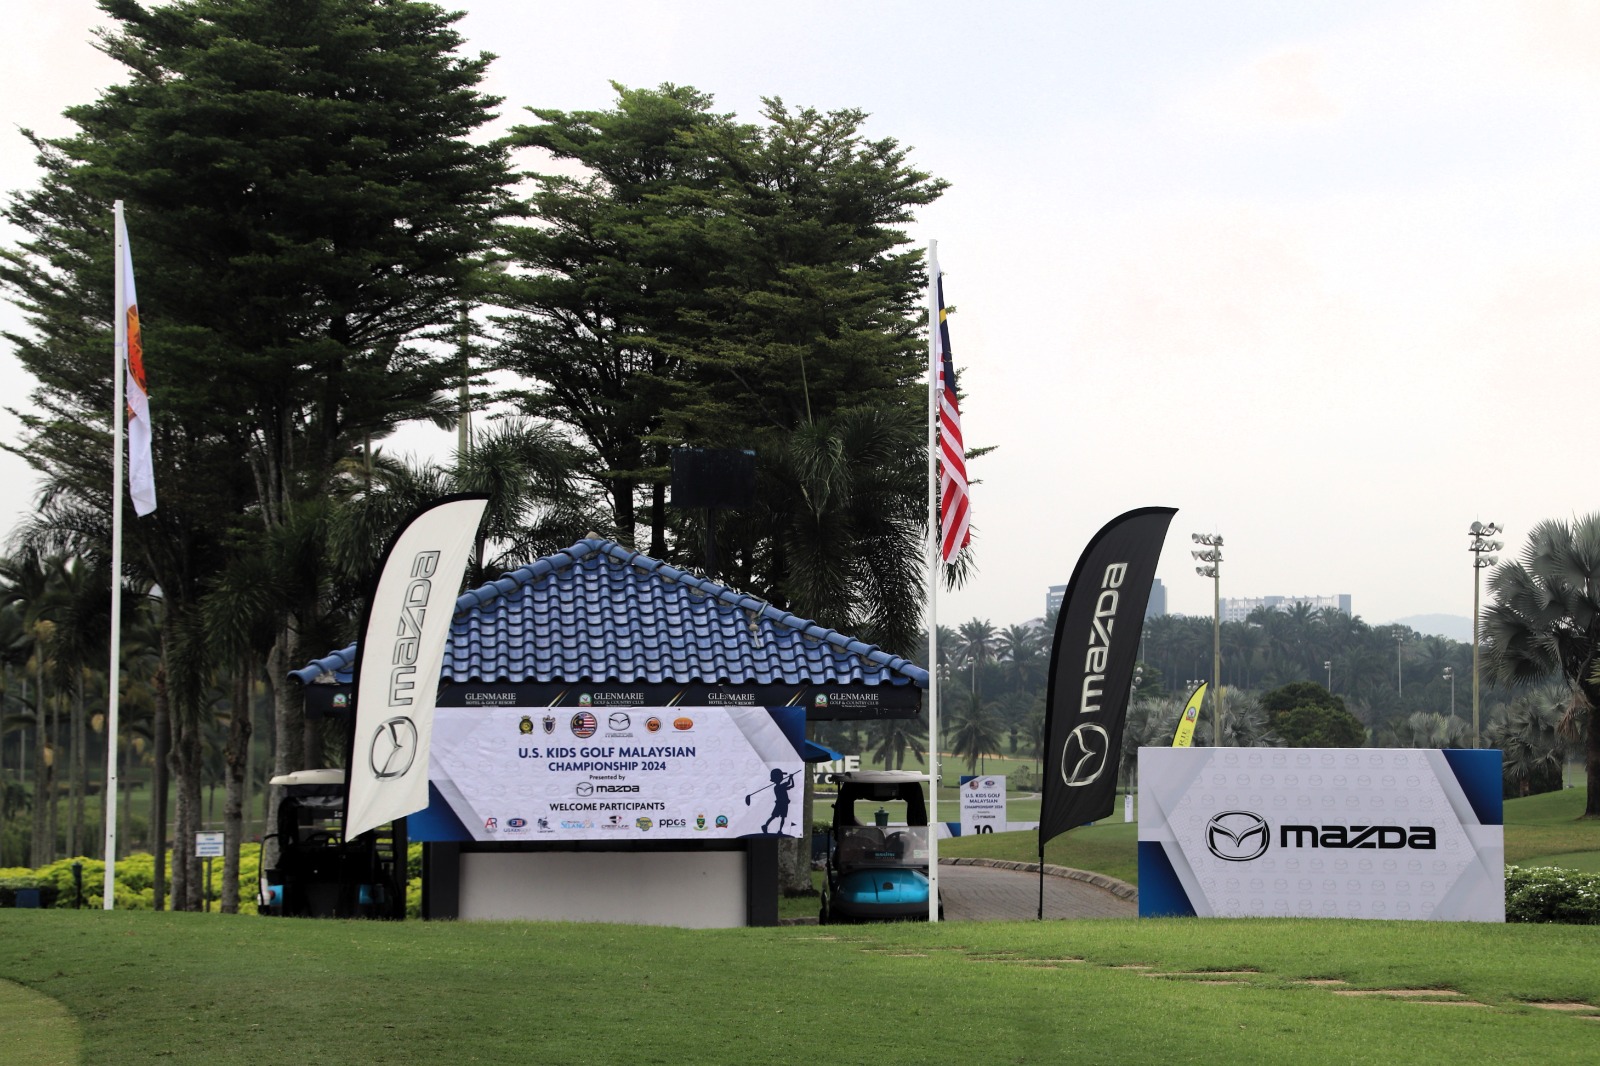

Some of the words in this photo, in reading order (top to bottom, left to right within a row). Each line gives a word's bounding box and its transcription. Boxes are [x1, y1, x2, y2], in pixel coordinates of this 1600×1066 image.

[388, 550, 441, 707] mazda
[1080, 562, 1128, 713] mazda
[465, 692, 516, 700] GLENMARIE
[593, 692, 644, 700] GLENMARIE
[708, 692, 755, 701] GLENMARIE
[829, 692, 879, 701] GLENMARIE
[518, 747, 543, 759] U.S.
[546, 747, 576, 758] KIDS
[580, 747, 615, 758] GOLF
[619, 746, 696, 758] MALAYSIAN
[548, 762, 638, 771] CHAMPIONSHIP
[641, 761, 667, 771] 2024
[596, 785, 640, 793] mazda
[549, 803, 597, 811] WELCOME
[600, 802, 665, 810] PARTICIPANTS
[1280, 825, 1437, 850] mazda
